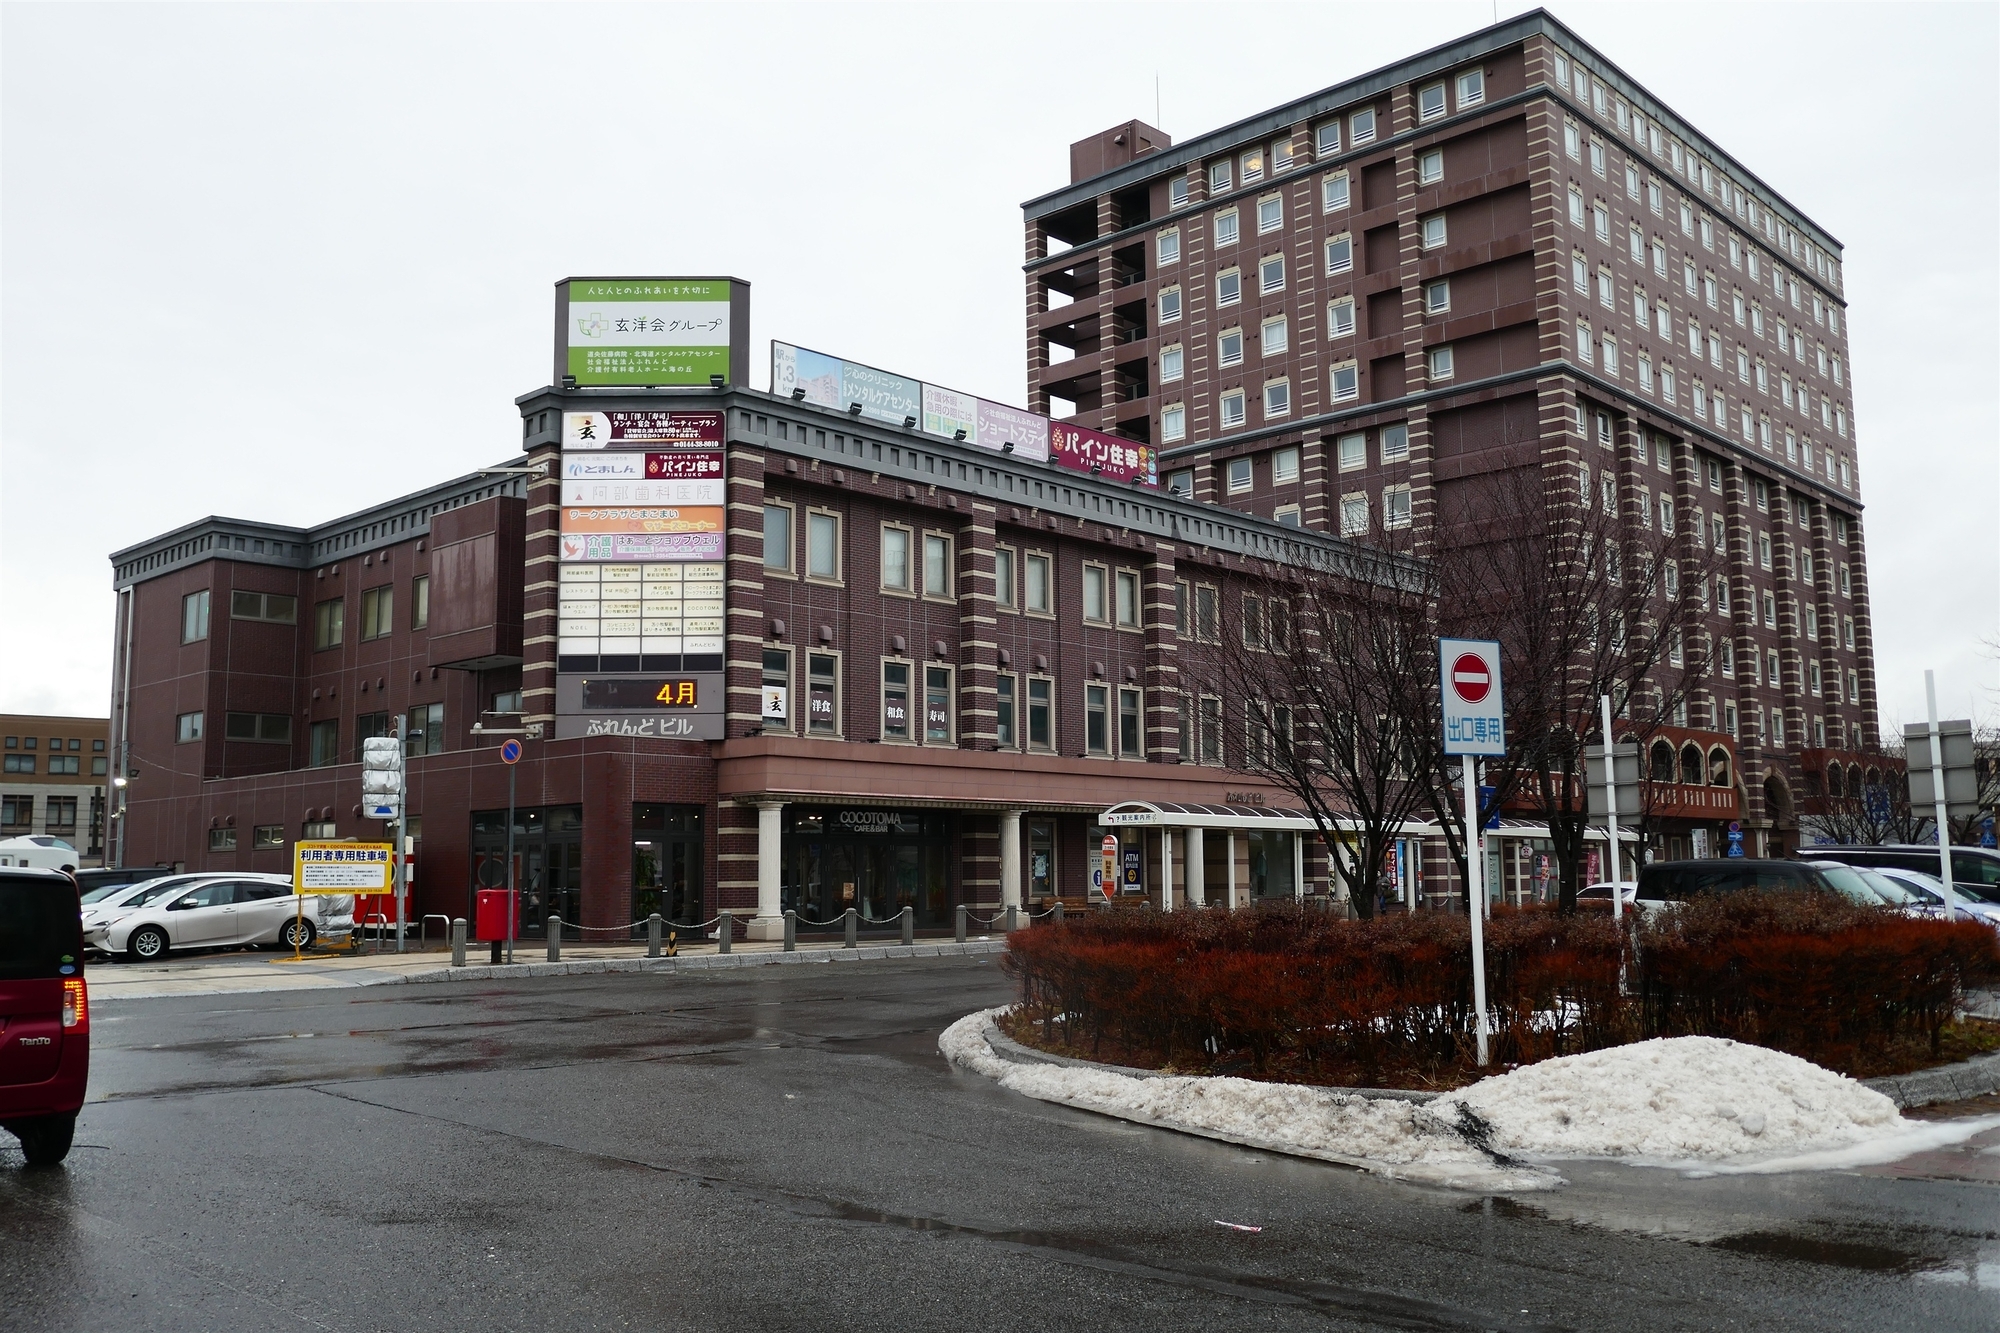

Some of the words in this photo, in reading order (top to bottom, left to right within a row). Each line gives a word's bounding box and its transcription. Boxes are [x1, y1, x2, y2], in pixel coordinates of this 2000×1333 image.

[588, 286, 710, 295] 人と人とのふれあいを大切に
[615, 316, 723, 333] 玄洋会グループ
[776, 348, 796, 362] 駅から
[776, 362, 795, 383] 1.3
[852, 369, 903, 390] 心のクリニック
[847, 382, 920, 412] メンタルケアセンター
[926, 402, 973, 422] 急用の際には
[979, 416, 1048, 448] ショートステイ
[1065, 432, 1139, 469] パイン住幸
[585, 465, 636, 474] とましん
[661, 460, 720, 473] パイン住幸
[592, 485, 712, 501] 阿部歯科医院
[588, 536, 613, 548] 介護
[588, 547, 613, 558] 用品
[656, 682, 694, 704] 4月
[812, 699, 831, 713] 洋食
[886, 706, 904, 719] 和食
[929, 710, 945, 723] 寿司
[586, 718, 654, 735] ふれんど
[660, 718, 693, 735] ビル
[1448, 715, 1501, 744] 出口専用
[840, 811, 902, 825] COCOTOMA
[854, 824, 889, 833] CAFE&BAR
[300, 850, 388, 862] 利用者専用駐車場
[1124, 853, 1139, 862] ATM
